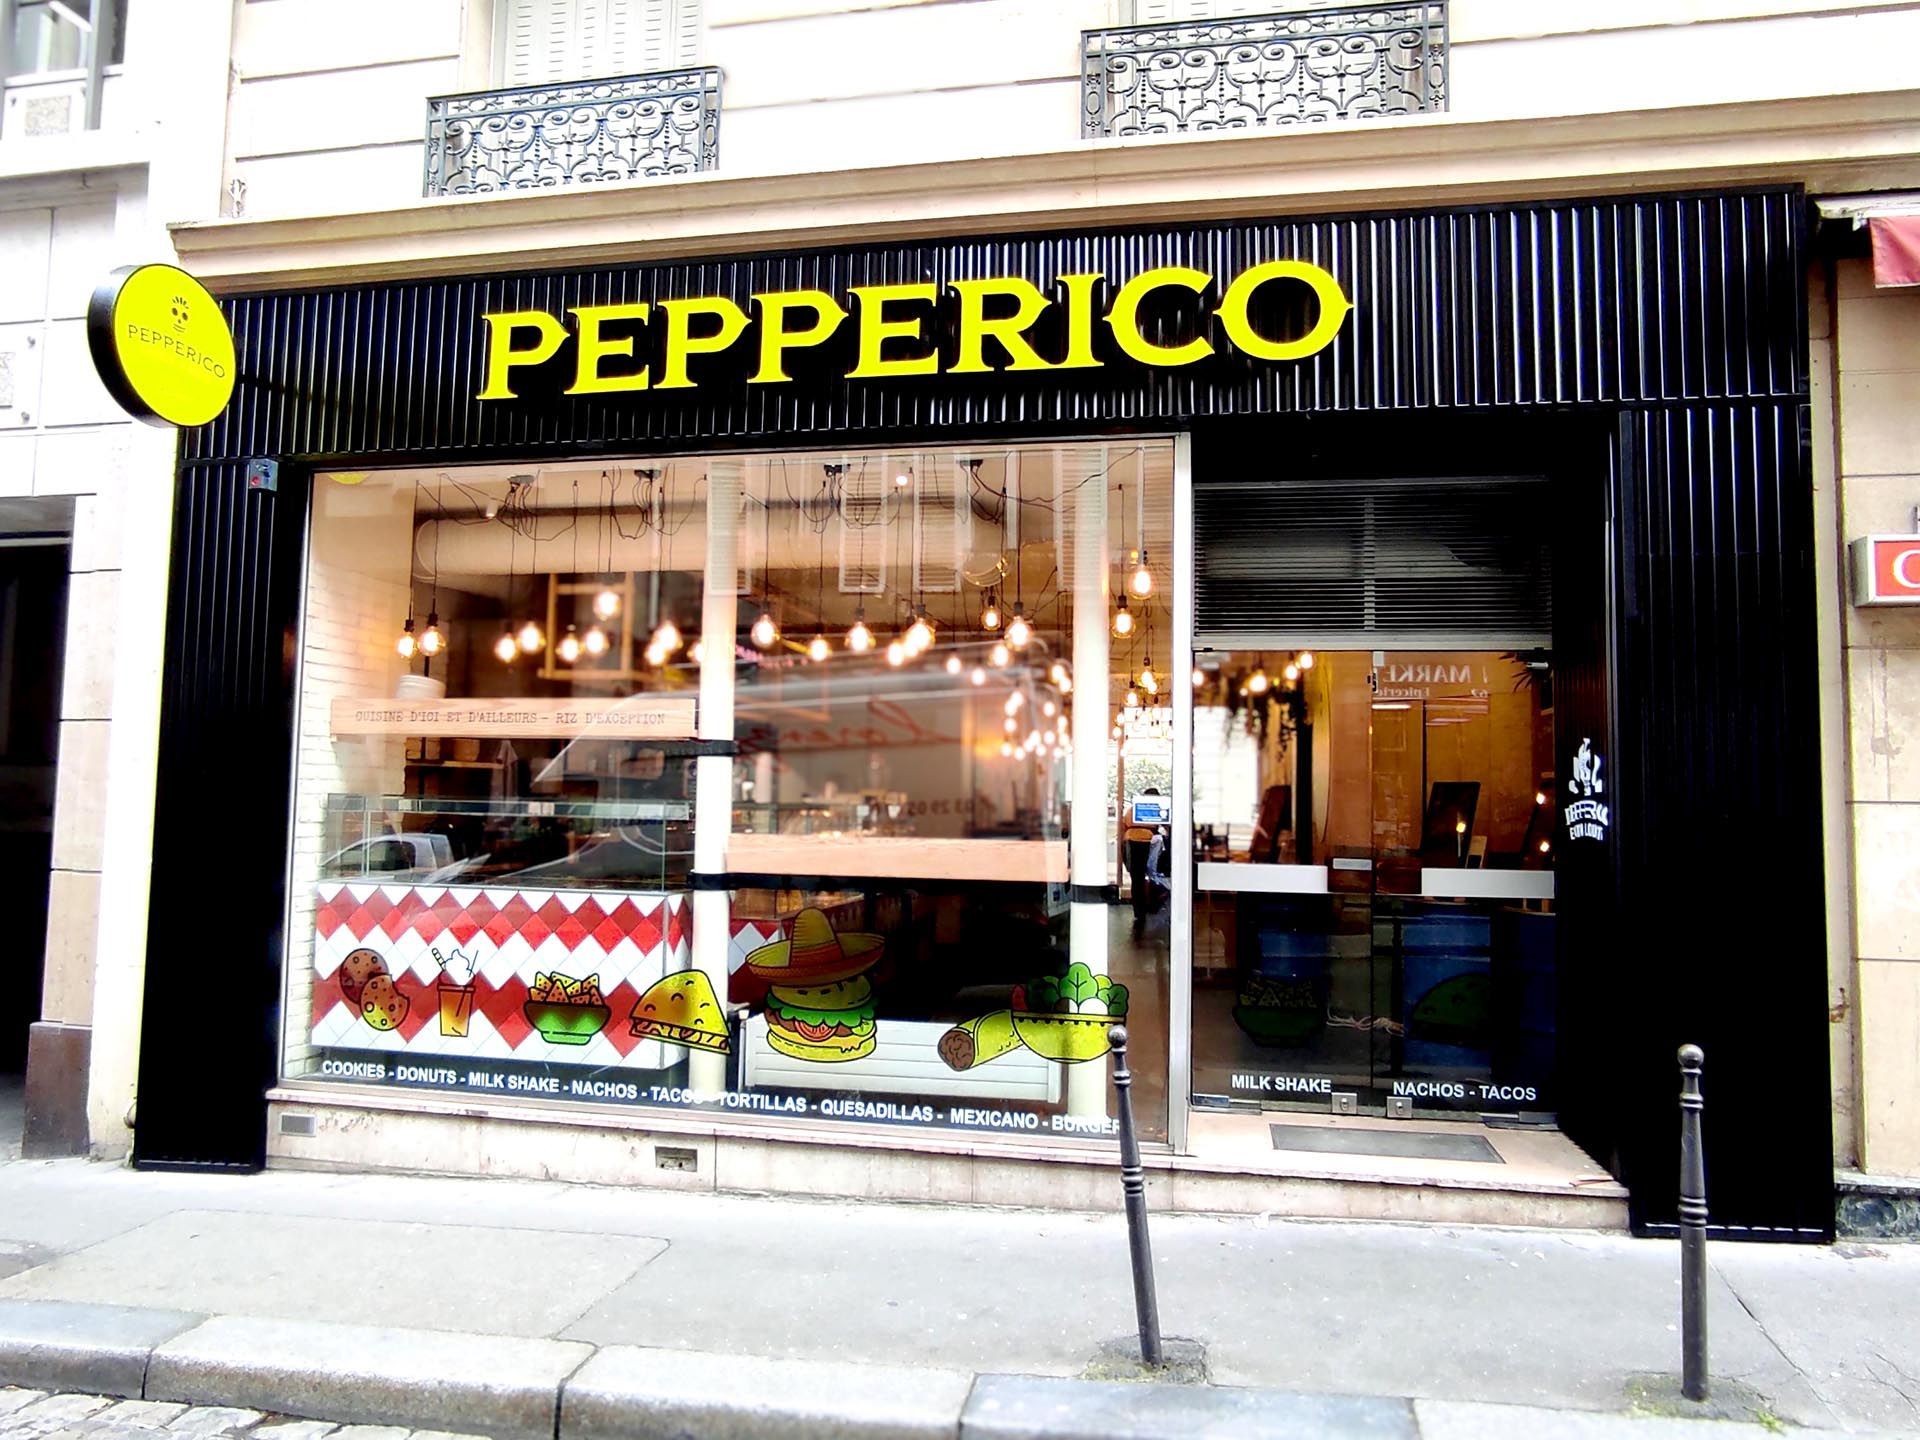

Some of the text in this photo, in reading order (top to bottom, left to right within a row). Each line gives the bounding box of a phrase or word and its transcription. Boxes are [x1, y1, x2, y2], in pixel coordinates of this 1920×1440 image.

[476, 260, 1355, 400] PEPPERICO
[127, 324, 226, 379] PEPPERICO
[355, 710, 403, 723] CUISINE
[410, 710, 440, 723] D'ICI
[446, 711, 462, 723] ET
[468, 711, 538, 724] D'AILLEURS
[556, 712, 578, 724] RIZ
[585, 712, 666, 726] D'EXCEPTION
[322, 1060, 386, 1079] COOKIES
[396, 1066, 457, 1084] DONUTS
[468, 1071, 505, 1089] MILK
[507, 1075, 560, 1093] SHAKE
[571, 1080, 638, 1099] NACHOS
[650, 1086, 704, 1105] TACOS
[717, 1091, 807, 1113] TORTILLAS
[820, 1099, 934, 1122] QUESADILLAS
[950, 1107, 1039, 1129] MEXICANO
[1231, 1074, 1332, 1093] MILK SHAKE
[1393, 1082, 1464, 1098] NACHOS
[1479, 1085, 1537, 1101] TACOS
